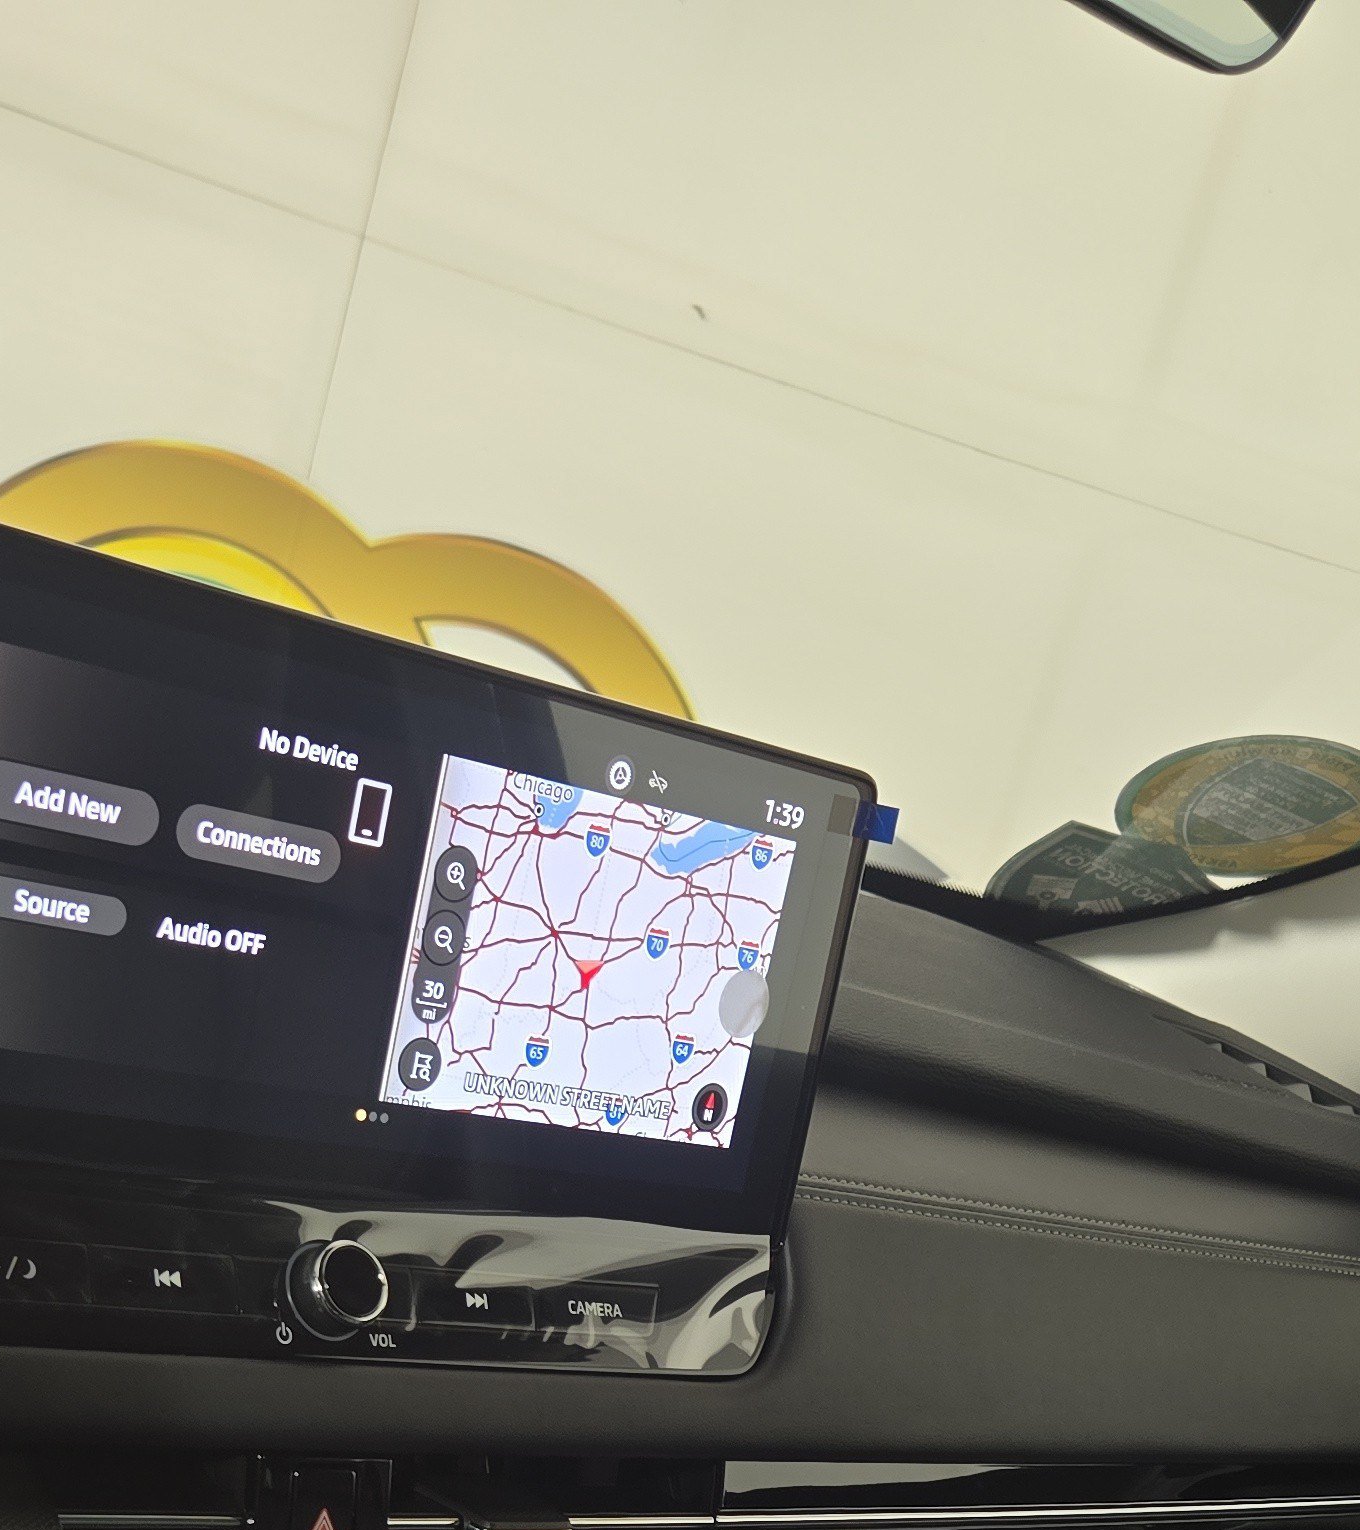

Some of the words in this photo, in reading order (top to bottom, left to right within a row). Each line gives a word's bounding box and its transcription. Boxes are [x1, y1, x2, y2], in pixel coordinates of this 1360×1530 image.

[259, 727, 290, 757] No
[293, 736, 359, 771] Device
[513, 773, 573, 803] Chicago
[15, 781, 66, 815] Add
[69, 791, 122, 826] New
[765, 799, 805, 829] 1:39
[196, 820, 322, 867] Connections
[590, 835, 605, 849] 80
[755, 850, 768, 863] 86
[14, 889, 90, 924] Source
[156, 917, 221, 949] Audio
[224, 927, 267, 955] OFF
[651, 939, 663, 951] 70
[741, 952, 753, 963] 76
[422, 979, 445, 999] 30
[422, 1008, 436, 1020] mi
[529, 1047, 543, 1059] 65
[675, 1045, 689, 1057] 64
[464, 1072, 559, 1104] UNKNOWN
[560, 1087, 622, 1113] STREET
[622, 1096, 672, 1121] NAME
[704, 1109, 713, 1122] N
[567, 1300, 623, 1318] CAMERA
[369, 1333, 397, 1348] VOL
